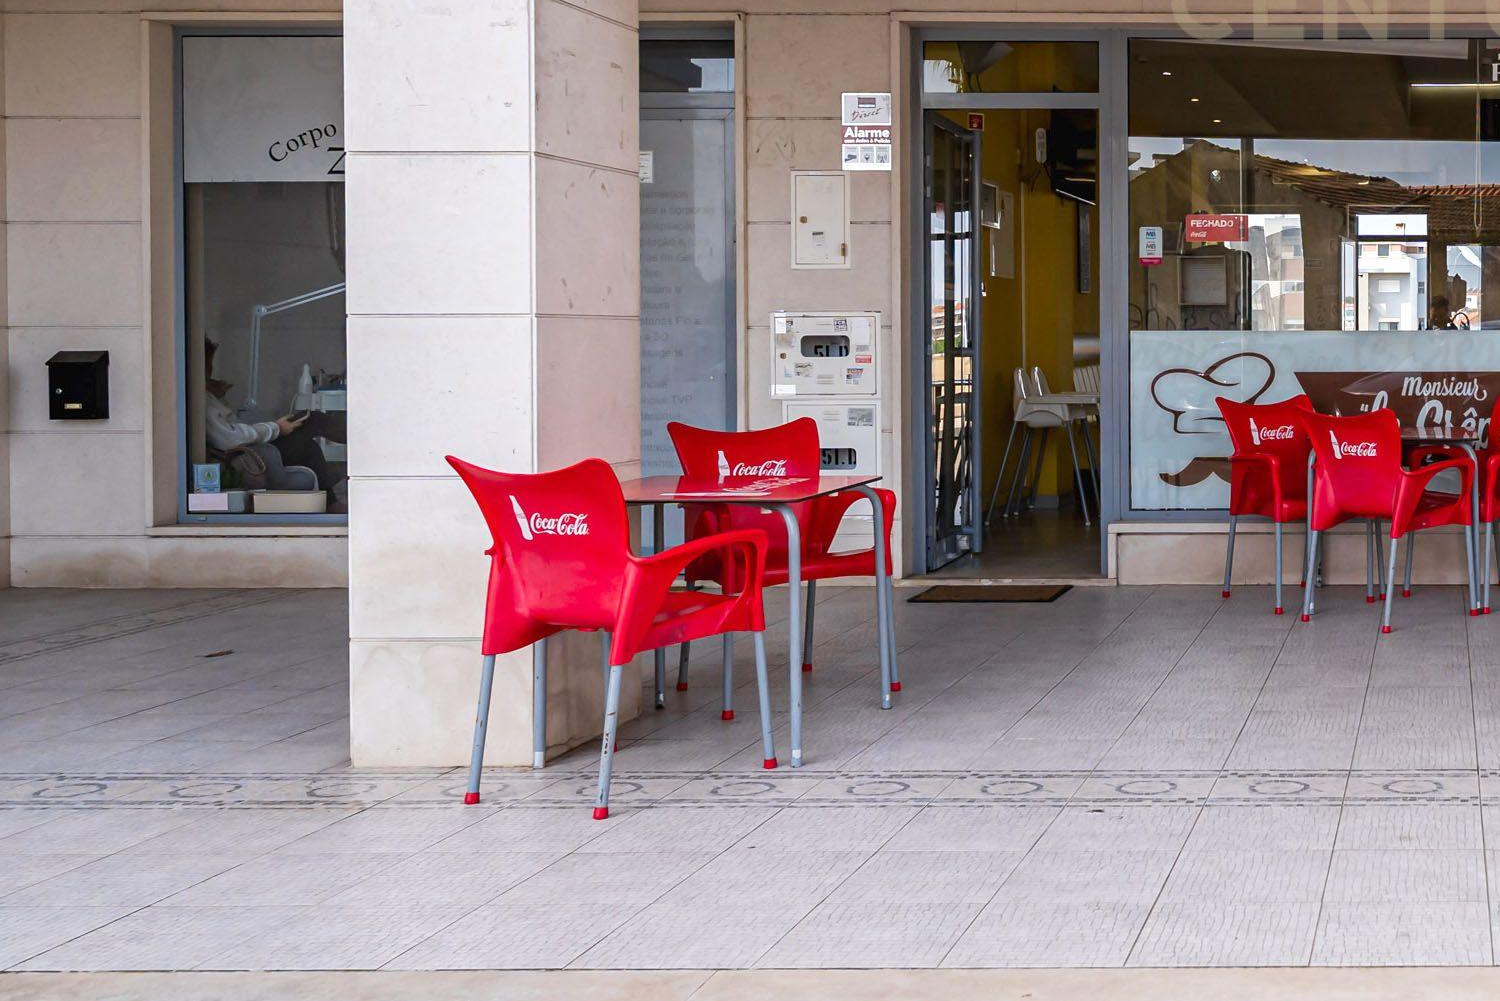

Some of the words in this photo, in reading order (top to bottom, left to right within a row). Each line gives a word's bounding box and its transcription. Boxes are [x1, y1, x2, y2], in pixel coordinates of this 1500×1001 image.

[844, 126, 891, 138] Alarme
[268, 123, 337, 162] Corpo
[1190, 219, 1234, 228] FECHADO
[1401, 376, 1488, 401] Monsieur
[1260, 424, 1295, 440] Coca-Cola
[1340, 441, 1378, 457] Coca-Cola
[529, 511, 590, 536] Coca-Cola
